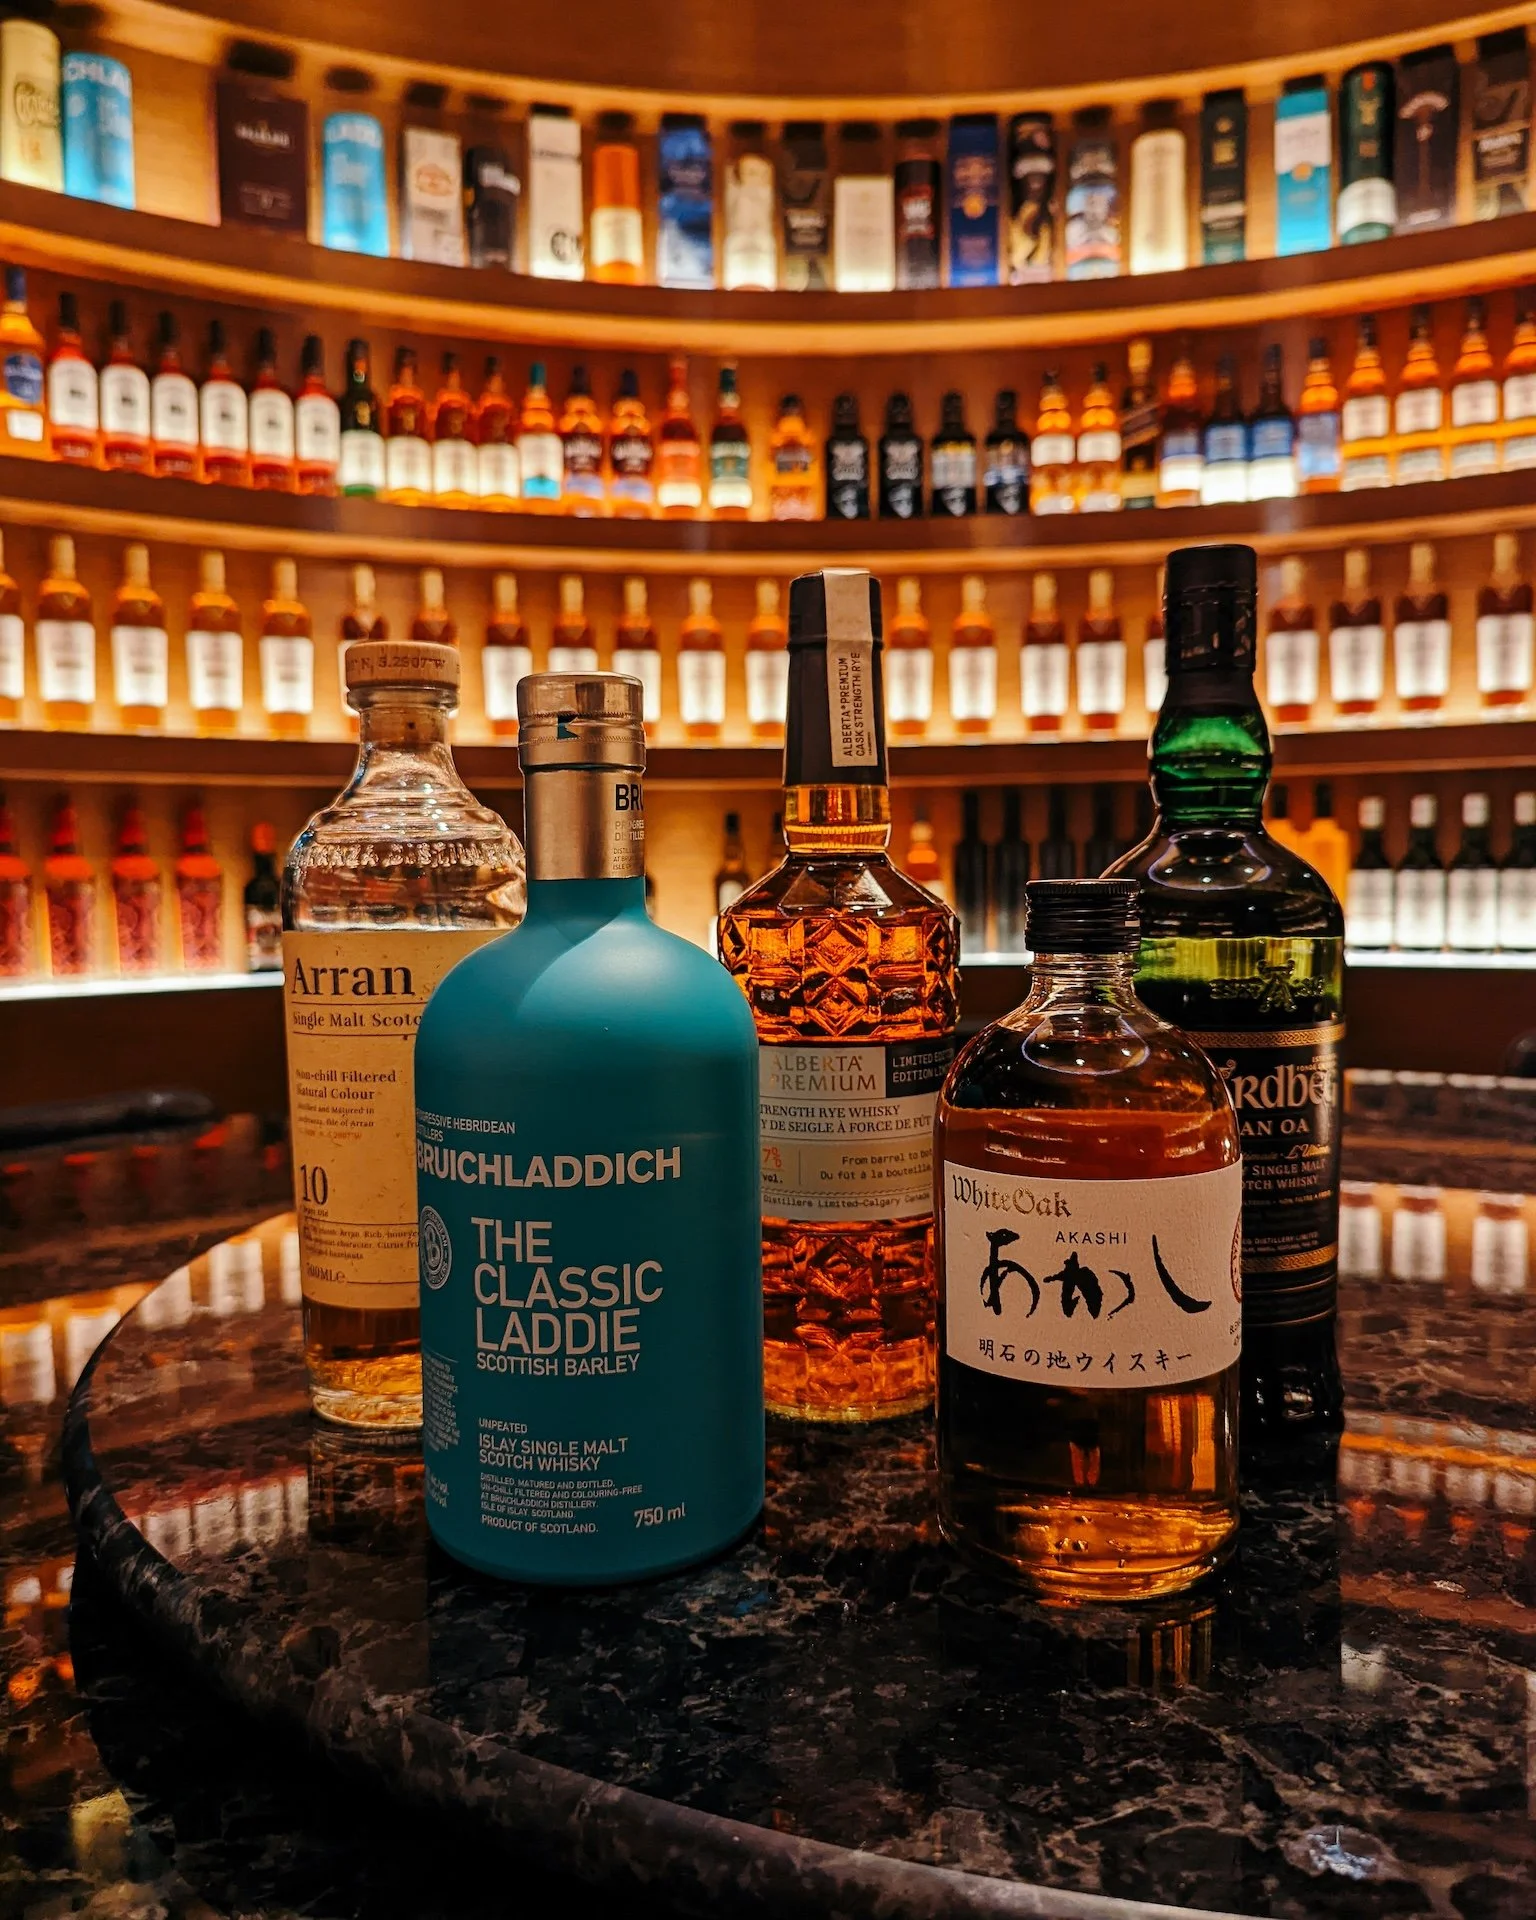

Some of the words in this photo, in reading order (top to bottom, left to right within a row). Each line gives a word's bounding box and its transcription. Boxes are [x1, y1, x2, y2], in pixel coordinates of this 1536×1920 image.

[850, 652, 861, 672] RYE
[852, 675, 864, 728] STRENGTH
[855, 729, 865, 757] CASK
[292, 958, 416, 996] Arran
[330, 1012, 366, 1028] Malt
[372, 1013, 422, 1027] Scotc
[770, 1055, 862, 1072] ALBERTA
[892, 1053, 933, 1068] LIMITED
[341, 1069, 397, 1083] Filtered
[770, 1074, 877, 1092] PREMIUM
[892, 1068, 934, 1083] EDITION
[330, 1087, 375, 1100] Colour
[760, 1103, 815, 1117] TRENGTH
[819, 1107, 846, 1119] RYE
[848, 1104, 901, 1118] WHISKY
[453, 1117, 516, 1134] HEBRIDEAN
[769, 1120, 786, 1132] DE
[788, 1120, 835, 1133] SEIGLE
[837, 1119, 846, 1134] À
[849, 1121, 893, 1134] FORCE
[895, 1118, 912, 1130] DE
[1240, 1120, 1273, 1136] AN
[1280, 1118, 1311, 1135] OA
[417, 1139, 681, 1188] BRUICHLADDICH
[842, 1155, 868, 1165] From
[870, 1152, 905, 1164] barrel
[908, 1151, 918, 1160] to
[1252, 1163, 1298, 1176] SINGLE
[1301, 1158, 1326, 1172] MALT
[820, 1170, 834, 1180] Du
[871, 1169, 883, 1179] la
[886, 1163, 932, 1177] bouteille
[300, 1163, 329, 1206] 10
[1276, 1174, 1319, 1190] WHISKY
[763, 1194, 813, 1207] Distillers
[470, 1216, 553, 1264] THE
[1055, 1231, 1128, 1245] AKASHI
[474, 1259, 664, 1310] CLASSIC
[475, 1306, 641, 1355] LADDIE
[476, 1351, 559, 1376] SCOTTISH
[564, 1352, 641, 1377] BARLEY
[978, 1337, 1193, 1375] 明石の地ウイスキー
[478, 1416, 529, 1434] UNPEATED
[479, 1432, 518, 1453] ISLAY
[520, 1439, 580, 1456] SINGLE
[583, 1437, 629, 1455] MALT
[479, 1448, 534, 1471] SCOTCH
[537, 1456, 601, 1473] WHISKY
[515, 1487, 551, 1499] FILTERED
[552, 1490, 570, 1500] AND
[571, 1484, 644, 1500] COLOURING-FREE
[518, 1479, 556, 1490] MATURED
[557, 1480, 575, 1490] AND
[480, 1491, 489, 1501] AT
[490, 1493, 550, 1509] BRUICHLADDICH
[481, 1501, 496, 1512] ISLE
[497, 1504, 506, 1513] OF
[481, 1514, 523, 1532] PRODUCT
[524, 1521, 539, 1533] OF
[540, 1522, 600, 1535] SCOTLAND.
[633, 1505, 665, 1530] 750
[667, 1501, 686, 1523] ml
